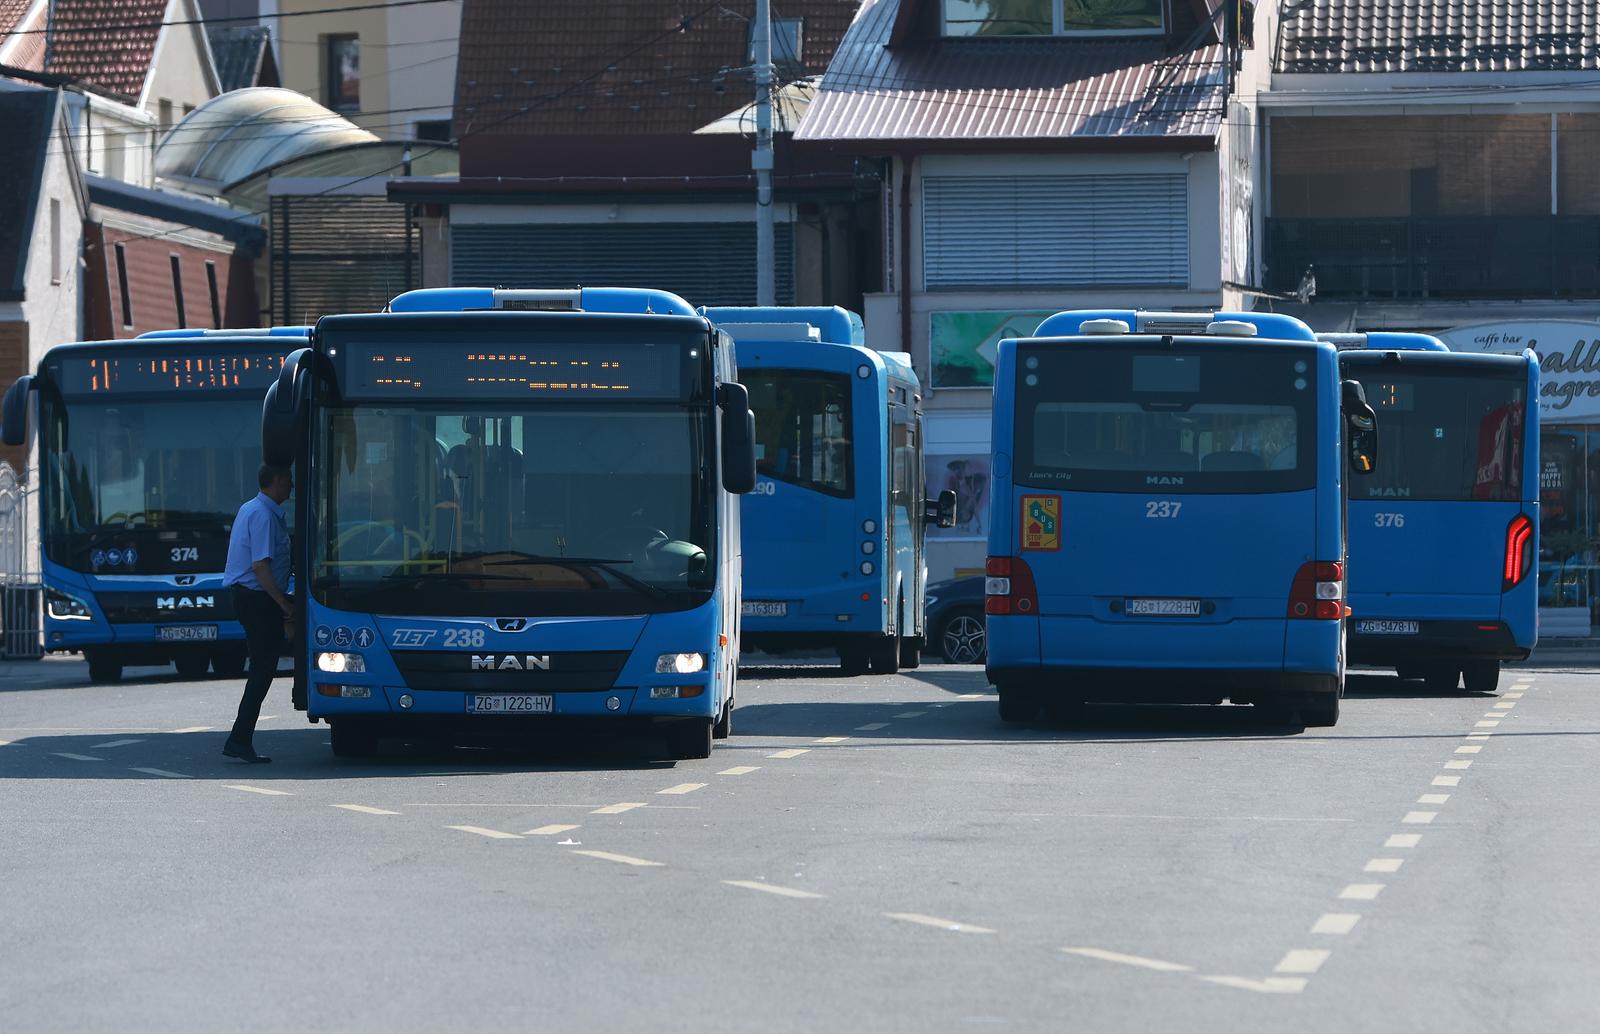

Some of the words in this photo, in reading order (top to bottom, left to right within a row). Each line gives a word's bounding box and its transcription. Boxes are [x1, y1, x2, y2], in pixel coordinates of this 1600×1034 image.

[1474, 333, 1500, 349] caffe
[1502, 332, 1522, 344] bar
[1146, 476, 1184, 485] MAN
[1369, 487, 1410, 497] MAN
[1146, 501, 1182, 518] 237
[1374, 513, 1405, 528] 376
[170, 547, 200, 562] 374
[157, 596, 215, 610] MAN
[392, 628, 438, 647] ZET
[443, 628, 485, 648] 238
[471, 655, 550, 670] MAN
